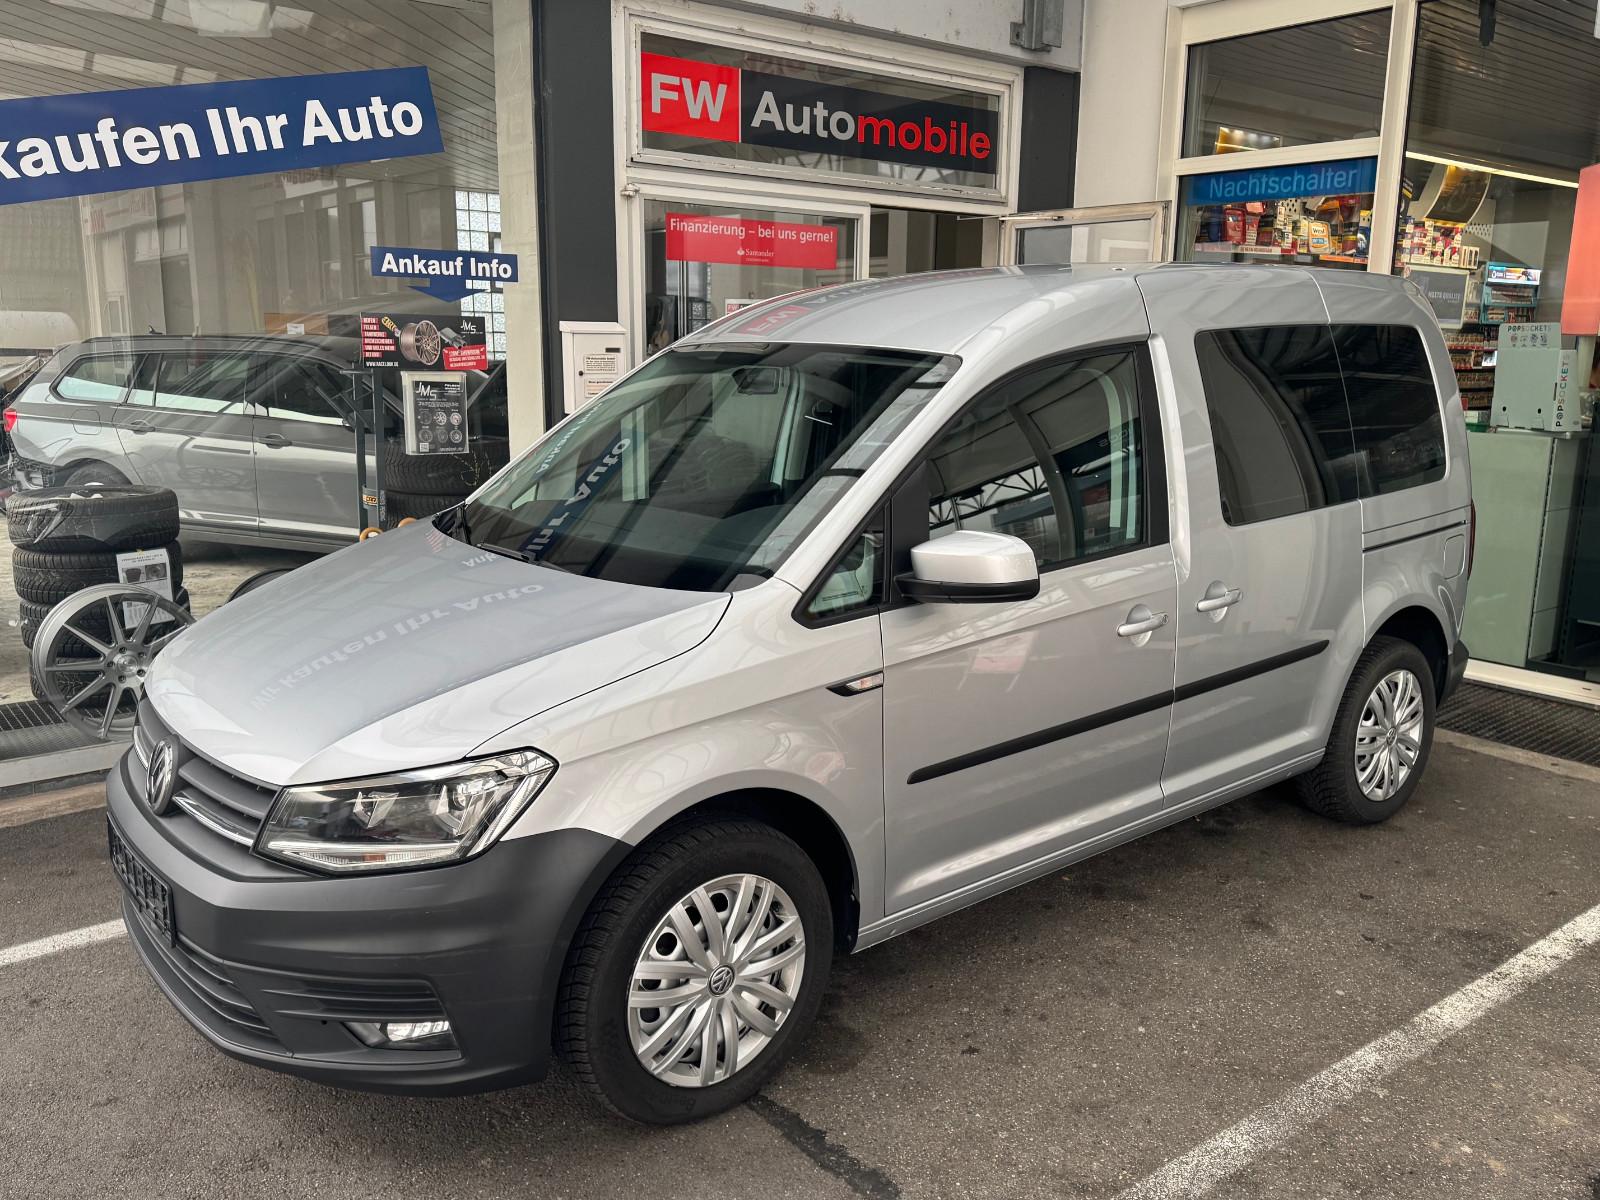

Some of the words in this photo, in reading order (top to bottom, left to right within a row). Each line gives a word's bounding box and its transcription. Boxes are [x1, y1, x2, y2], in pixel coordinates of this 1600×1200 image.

[207, 107, 288, 155] Ihr
[302, 95, 424, 147] Auto
[650, 72, 728, 123] FW
[750, 90, 991, 160] Automobile
[1209, 167, 1359, 199] Nachtschalter
[670, 218, 746, 240] Finanzierung
[758, 224, 775, 239] bei
[778, 229, 797, 240] uns
[799, 231, 834, 244] gerne!
[745, 247, 775, 257] Santander
[380, 253, 464, 276] Ankauf
[469, 257, 513, 279] Info
[416, 382, 438, 401] JMS
